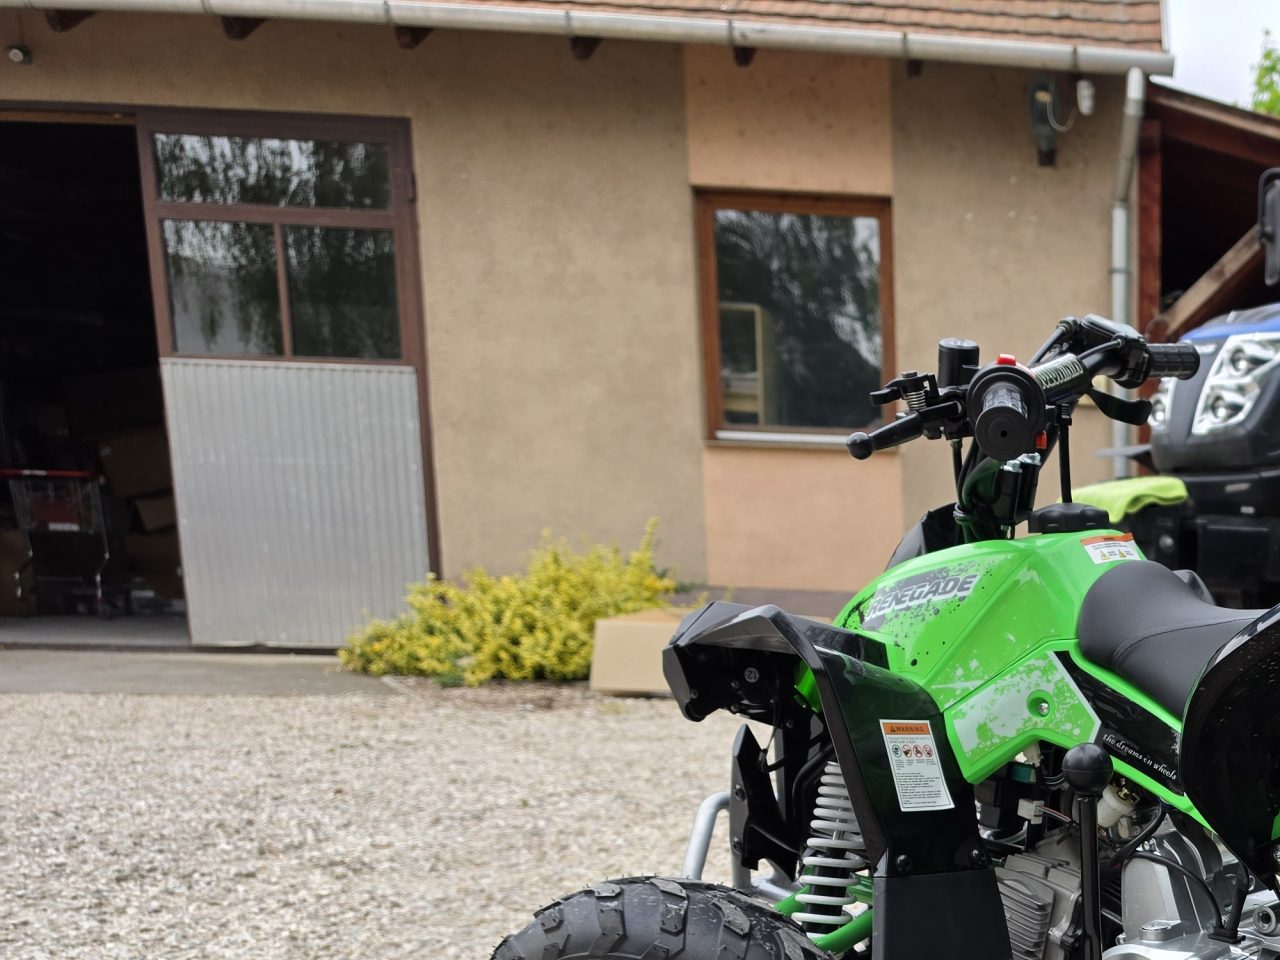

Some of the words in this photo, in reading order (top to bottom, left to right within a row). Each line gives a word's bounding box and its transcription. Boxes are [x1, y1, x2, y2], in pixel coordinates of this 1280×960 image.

[864, 573, 981, 622] RENEGADE
[896, 726, 925, 734] WARNING
[1116, 739, 1143, 761] dreams
[1153, 762, 1178, 781] wheels
